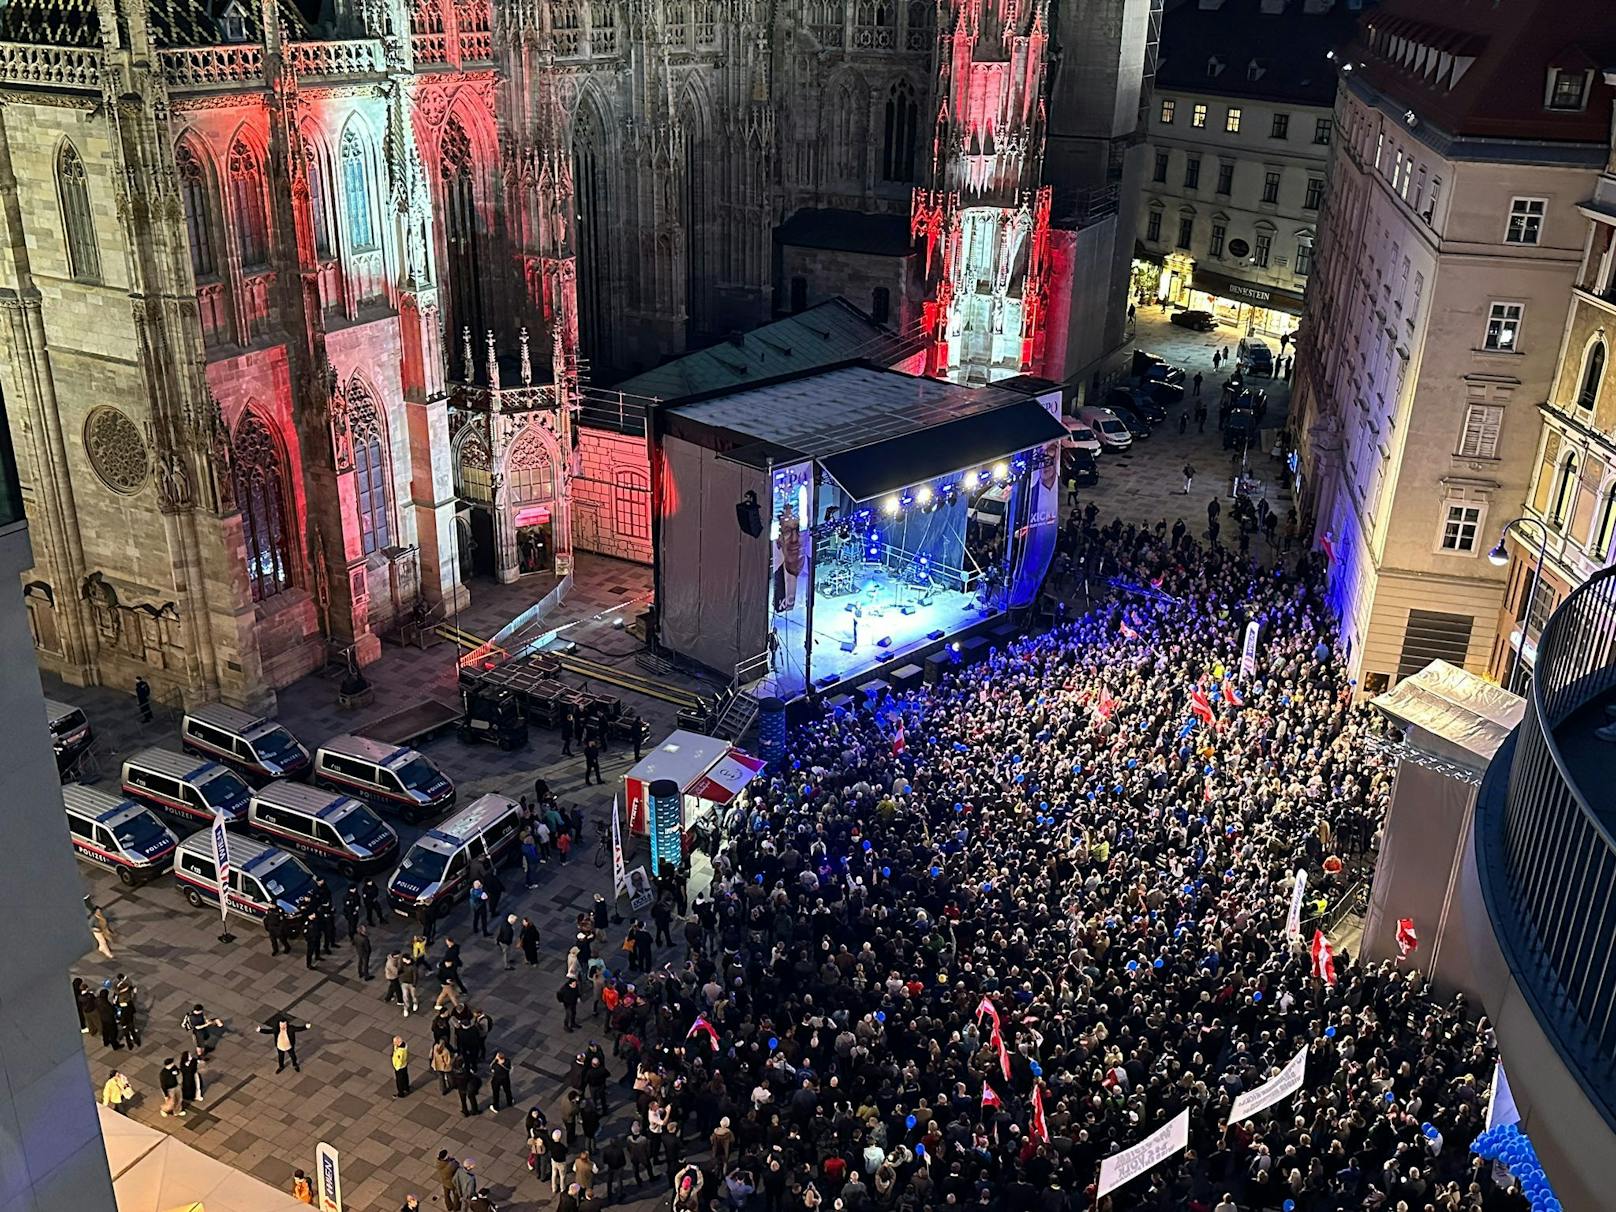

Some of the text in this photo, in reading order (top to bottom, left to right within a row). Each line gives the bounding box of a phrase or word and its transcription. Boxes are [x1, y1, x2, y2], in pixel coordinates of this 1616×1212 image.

[164, 805, 193, 820] POLIZEI
[78, 846, 107, 863] POLIZEI
[145, 839, 170, 854] POLIZEI
[295, 842, 327, 858] POLIZEI
[396, 880, 419, 892] POLIZEI
[226, 898, 252, 914] OLIZEI
[324, 1159, 333, 1195] WIEN
